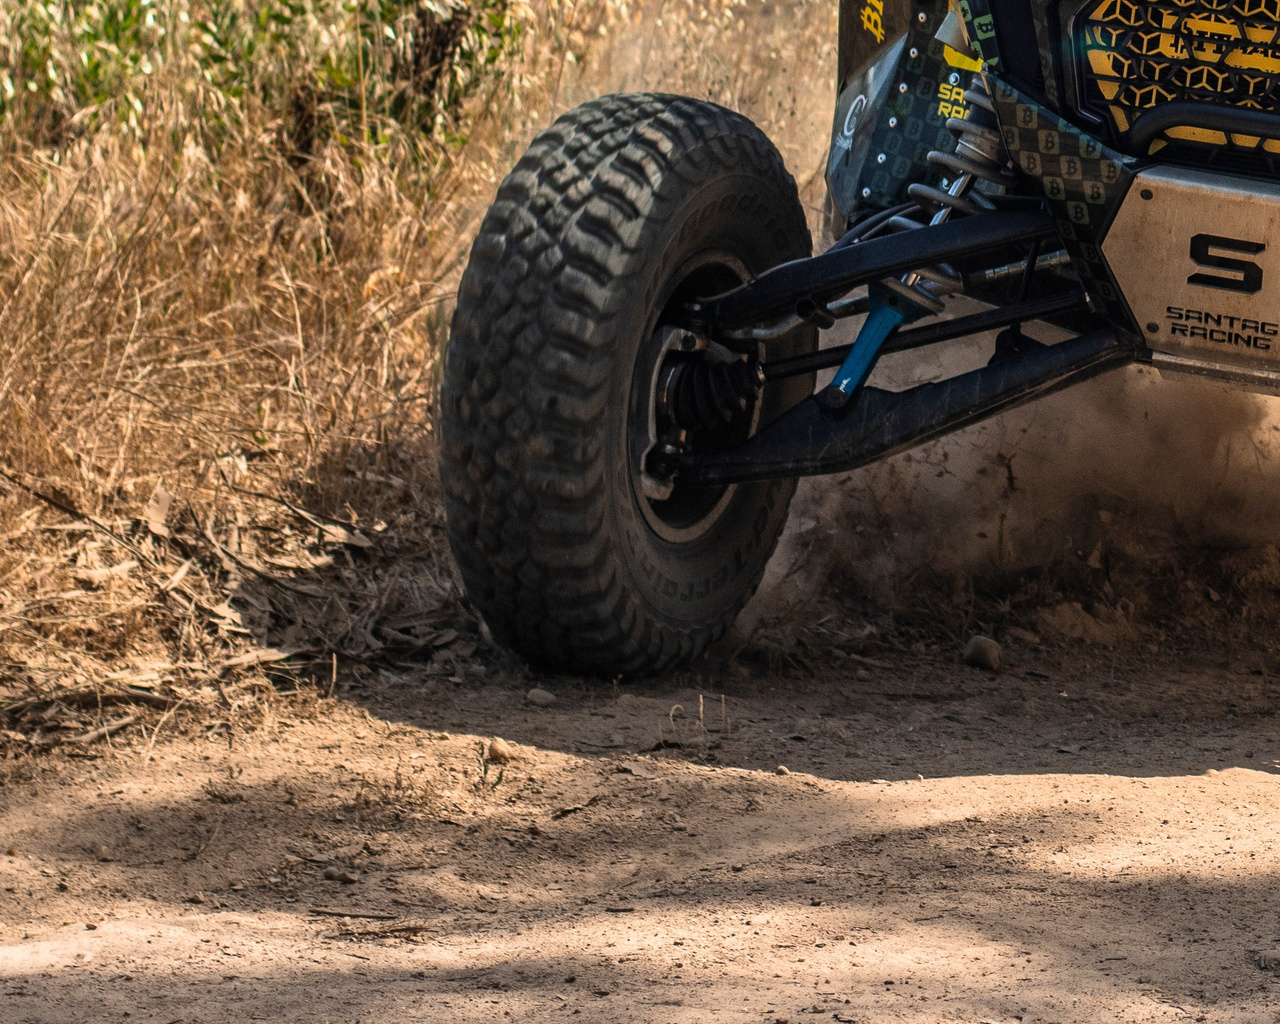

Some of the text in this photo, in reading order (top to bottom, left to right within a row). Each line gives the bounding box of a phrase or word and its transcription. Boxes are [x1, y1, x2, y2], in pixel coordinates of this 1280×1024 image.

[1187, 233, 1266, 295] S
[1166, 306, 1279, 336] SANTAG
[1171, 322, 1272, 351] RACING
